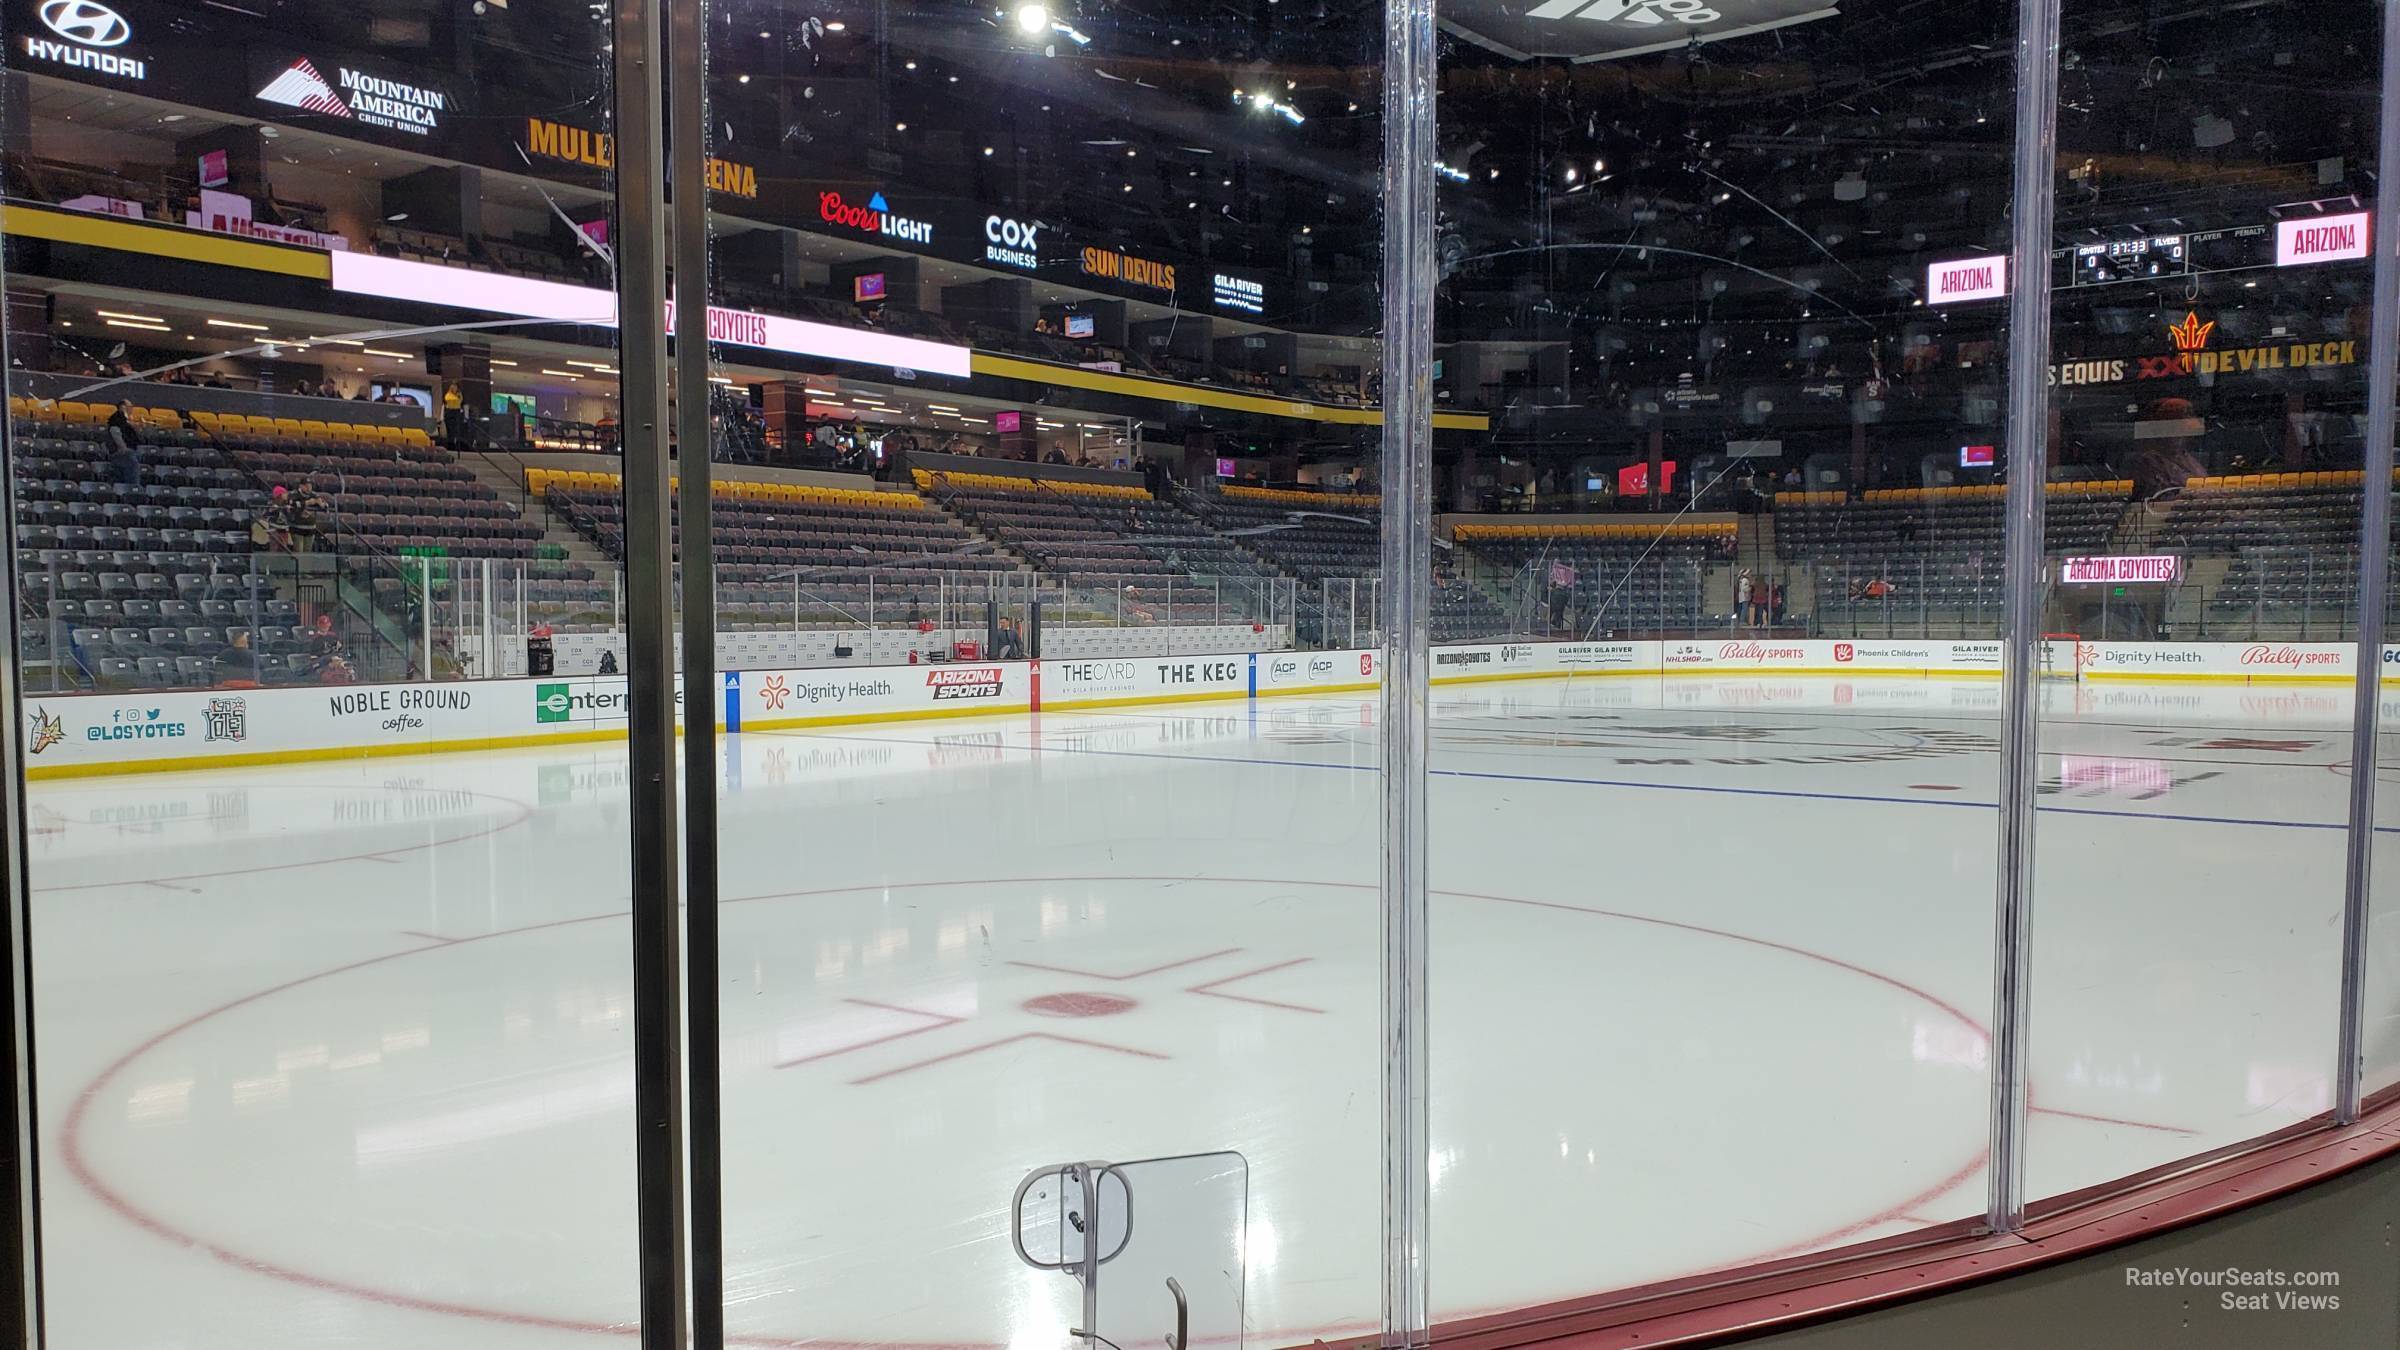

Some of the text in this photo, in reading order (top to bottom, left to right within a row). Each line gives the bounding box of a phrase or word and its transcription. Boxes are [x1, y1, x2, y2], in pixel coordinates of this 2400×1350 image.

[28, 37, 144, 79] HYUNDAI
[339, 67, 443, 110] MOUNTAIN
[348, 90, 438, 127] AMERICA
[358, 112, 428, 135] CREDIT UNION
[529, 117, 757, 199] MULL ENA
[819, 191, 932, 243] Coors LIGHT
[985, 215, 1037, 250] COX
[2193, 227, 2266, 242] PLAYER PENALTY
[2294, 224, 2355, 256] ARIZONA
[986, 245, 1037, 268] BUSINESS
[2112, 240, 2146, 255] 37:33
[2173, 246, 2181, 258] 0
[1083, 246, 1175, 291] SUN DEVILS
[1941, 266, 1993, 294] ARIZONA
[1214, 274, 1263, 296] GILA RIVER
[708, 308, 766, 346] COYOTES
[2201, 340, 2356, 374] DEVIL DECK
[2062, 360, 2124, 386] EQUIS
[2069, 558, 2171, 580] ARIZONA COYOTES
[1719, 641, 1804, 663] Bally SPORTS
[1857, 649, 1929, 658] Phoenix Children's
[1973, 645, 1999, 653] RIVER
[2105, 651, 2201, 664] Dignity Health
[2240, 645, 2340, 669] Bally SPORTS
[930, 670, 996, 684] ARIZONA
[1158, 662, 1238, 684] THE KEG
[1274, 663, 1296, 673] ACP
[1312, 661, 1333, 672] ACP
[796, 679, 892, 703] Dignity Health
[937, 683, 998, 698] SPORTS
[330, 689, 471, 717] NOBLE GROUND
[87, 723, 186, 741] @LOSYOTES
[382, 714, 424, 732] coffee
